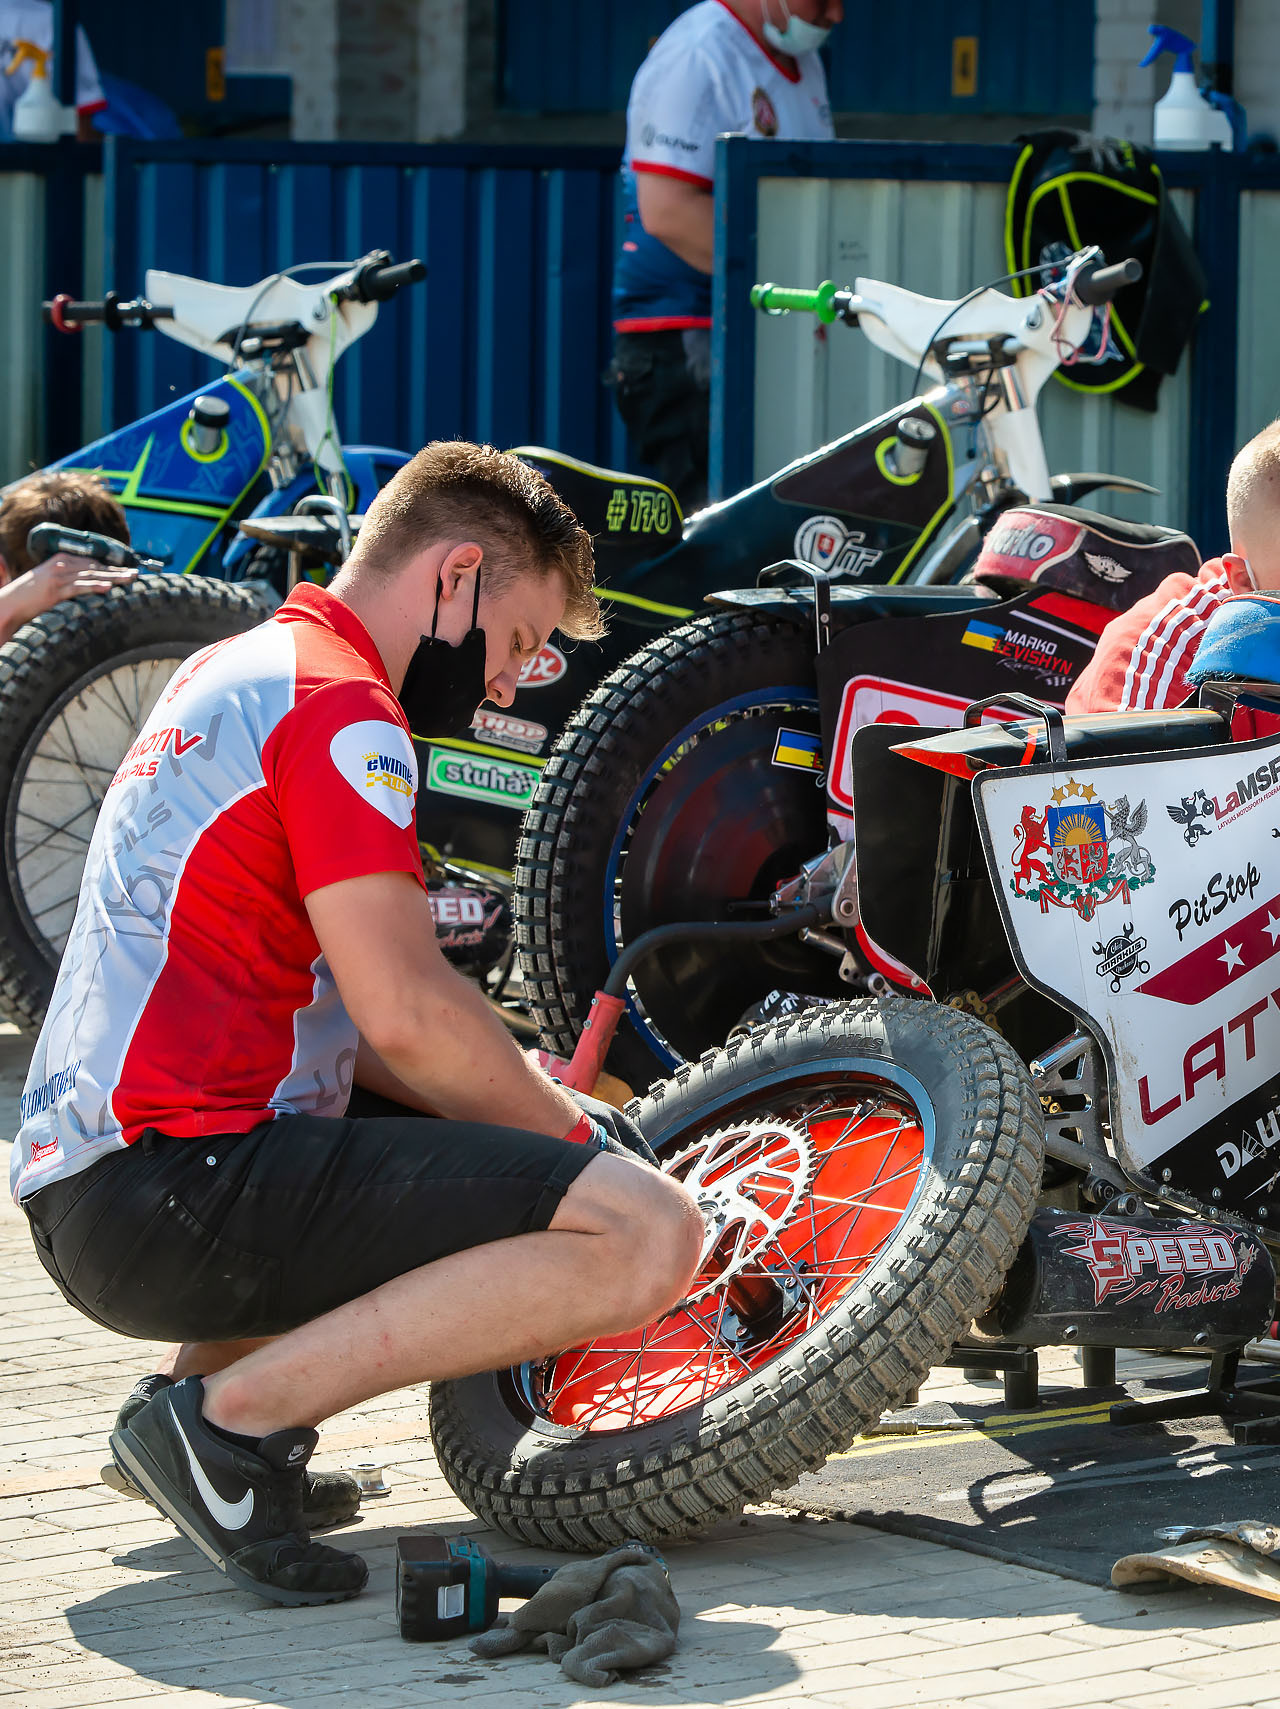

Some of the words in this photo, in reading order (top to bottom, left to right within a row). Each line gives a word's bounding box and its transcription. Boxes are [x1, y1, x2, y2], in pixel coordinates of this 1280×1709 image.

[606, 489, 672, 535] #178
[993, 640, 1072, 675] LEVISHYN
[1004, 630, 1057, 655] MARKO
[446, 761, 523, 795] stuha
[1169, 862, 1261, 942] PitStop
[1101, 941, 1142, 973] MARKUS
[1091, 1236, 1238, 1279] SPEED
[1154, 1273, 1242, 1315] Products
